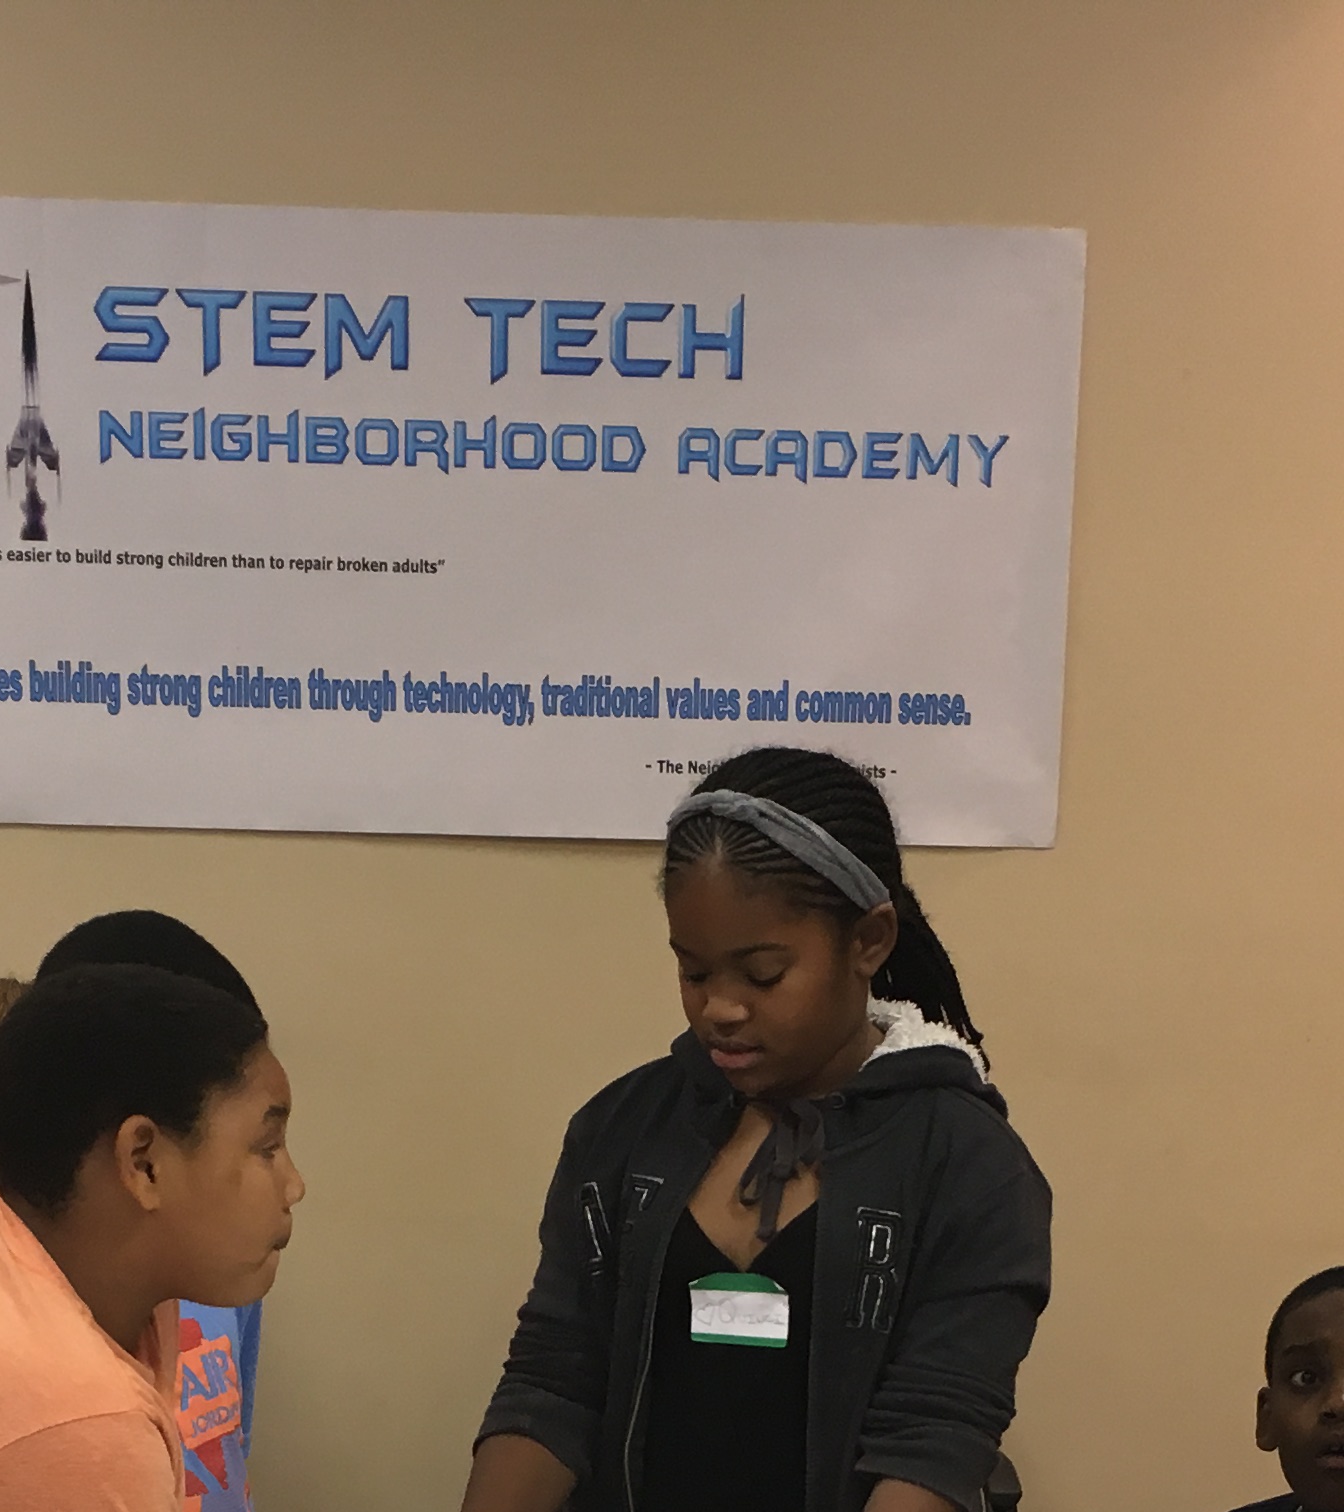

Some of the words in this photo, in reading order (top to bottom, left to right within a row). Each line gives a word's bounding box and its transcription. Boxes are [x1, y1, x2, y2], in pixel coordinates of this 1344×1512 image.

[93, 286, 410, 380] STEM
[464, 294, 746, 384] TECH
[99, 407, 647, 476] NEIGHBORHOOD
[678, 427, 1010, 488] ACADEMY
[7, 547, 52, 563] easier
[56, 549, 71, 563] to
[76, 549, 112, 564] build
[116, 551, 164, 569] strong
[168, 552, 228, 568] children
[232, 554, 265, 569] than
[269, 556, 285, 570] to
[289, 556, 333, 573] repair
[337, 557, 388, 572] broken
[29, 660, 121, 715] building
[127, 664, 201, 718] strong
[208, 665, 301, 709] children
[308, 668, 396, 723] through
[403, 671, 534, 726] technology,
[542, 675, 659, 718] traditional
[666, 678, 741, 721] values
[747, 680, 789, 721] and
[795, 687, 891, 723] common
[897, 691, 971, 726] sense.
[657, 760, 683, 774] The
[181, 1349, 235, 1411] AIR
[192, 1402, 240, 1438] JORD
